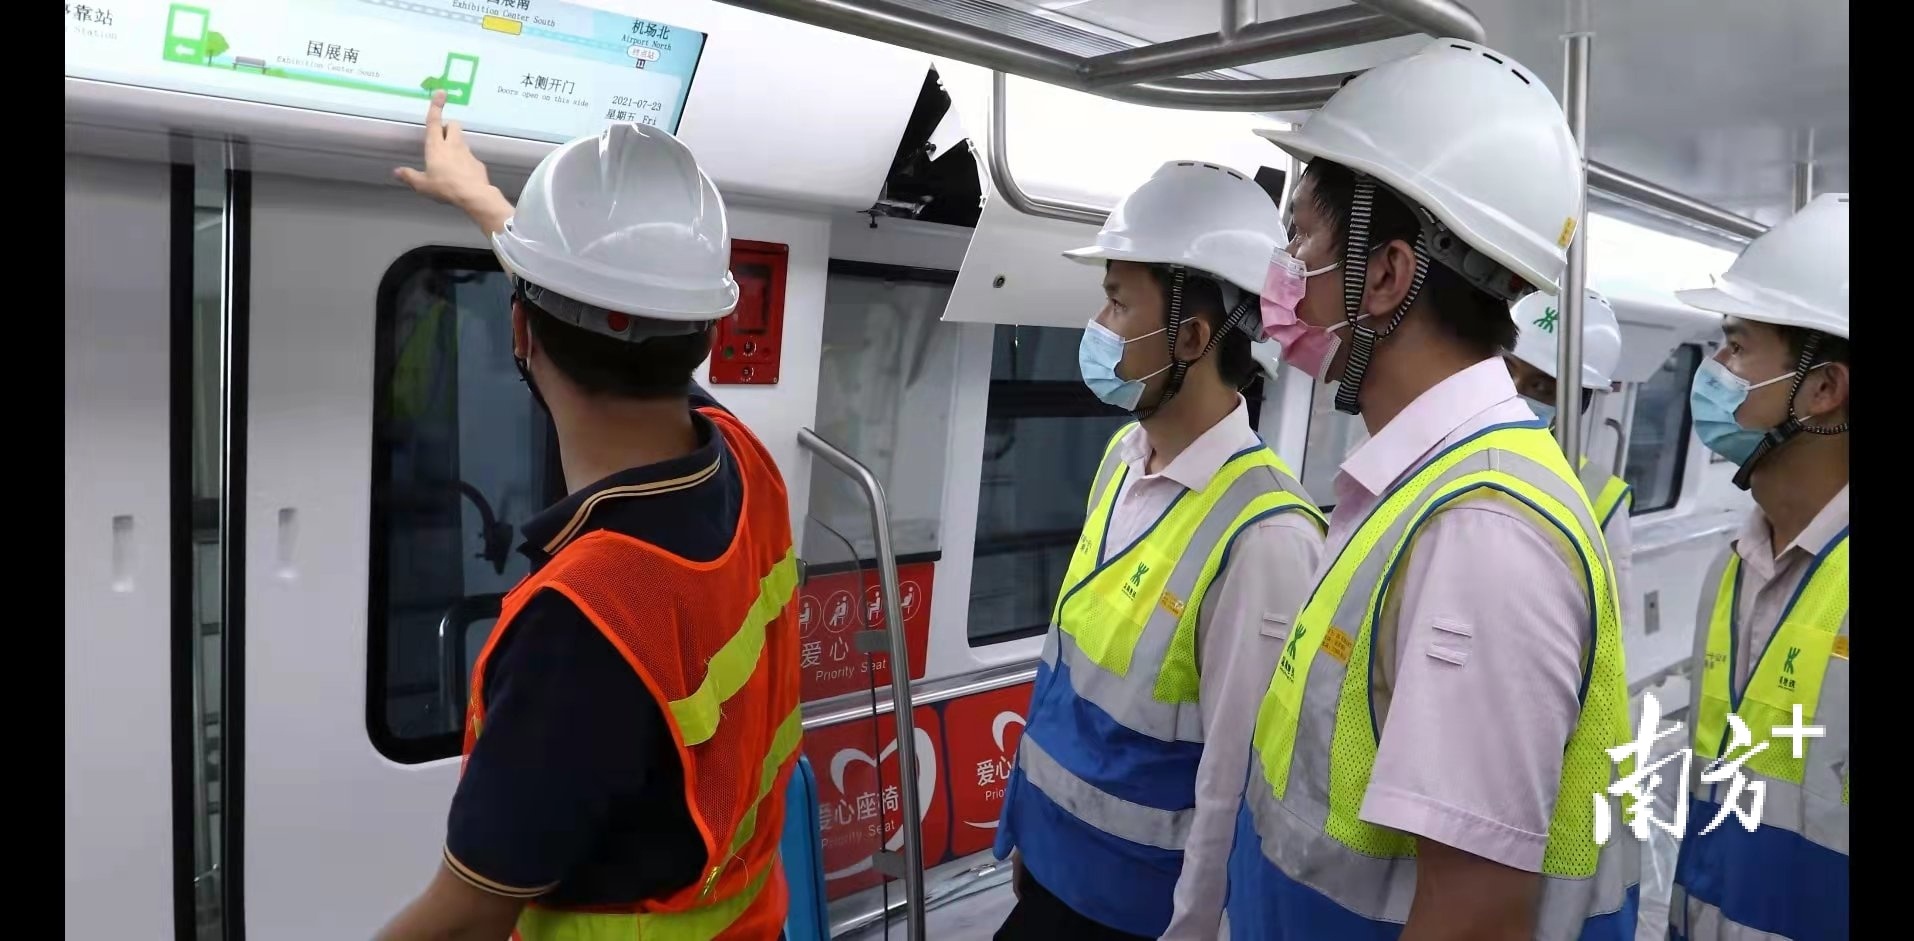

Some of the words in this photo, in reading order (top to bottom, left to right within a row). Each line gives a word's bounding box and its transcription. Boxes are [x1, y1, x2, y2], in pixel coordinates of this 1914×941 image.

[452, 0, 499, 15] Exhibition
[503, 9, 530, 21] Center
[533, 15, 556, 27] South
[632, 20, 670, 40] 机场北
[306, 40, 361, 64] 国展南
[621, 34, 650, 46] Airport
[651, 40, 672, 51] North
[520, 73, 576, 95] 本侧开门
[497, 85, 519, 96] Doors
[521, 91, 539, 99] open
[554, 96, 570, 104] this
[572, 99, 589, 107] side
[611, 95, 662, 111] 2021-07-23
[605, 108, 637, 121] 星期五
[642, 114, 657, 126] Fri
[800, 635, 870, 669] 爱心
[815, 665, 855, 682] Priority
[860, 658, 886, 673] Seat
[976, 755, 1012, 787] 爱心
[985, 787, 1007, 801] Prio
[867, 819, 896, 838] Seat
